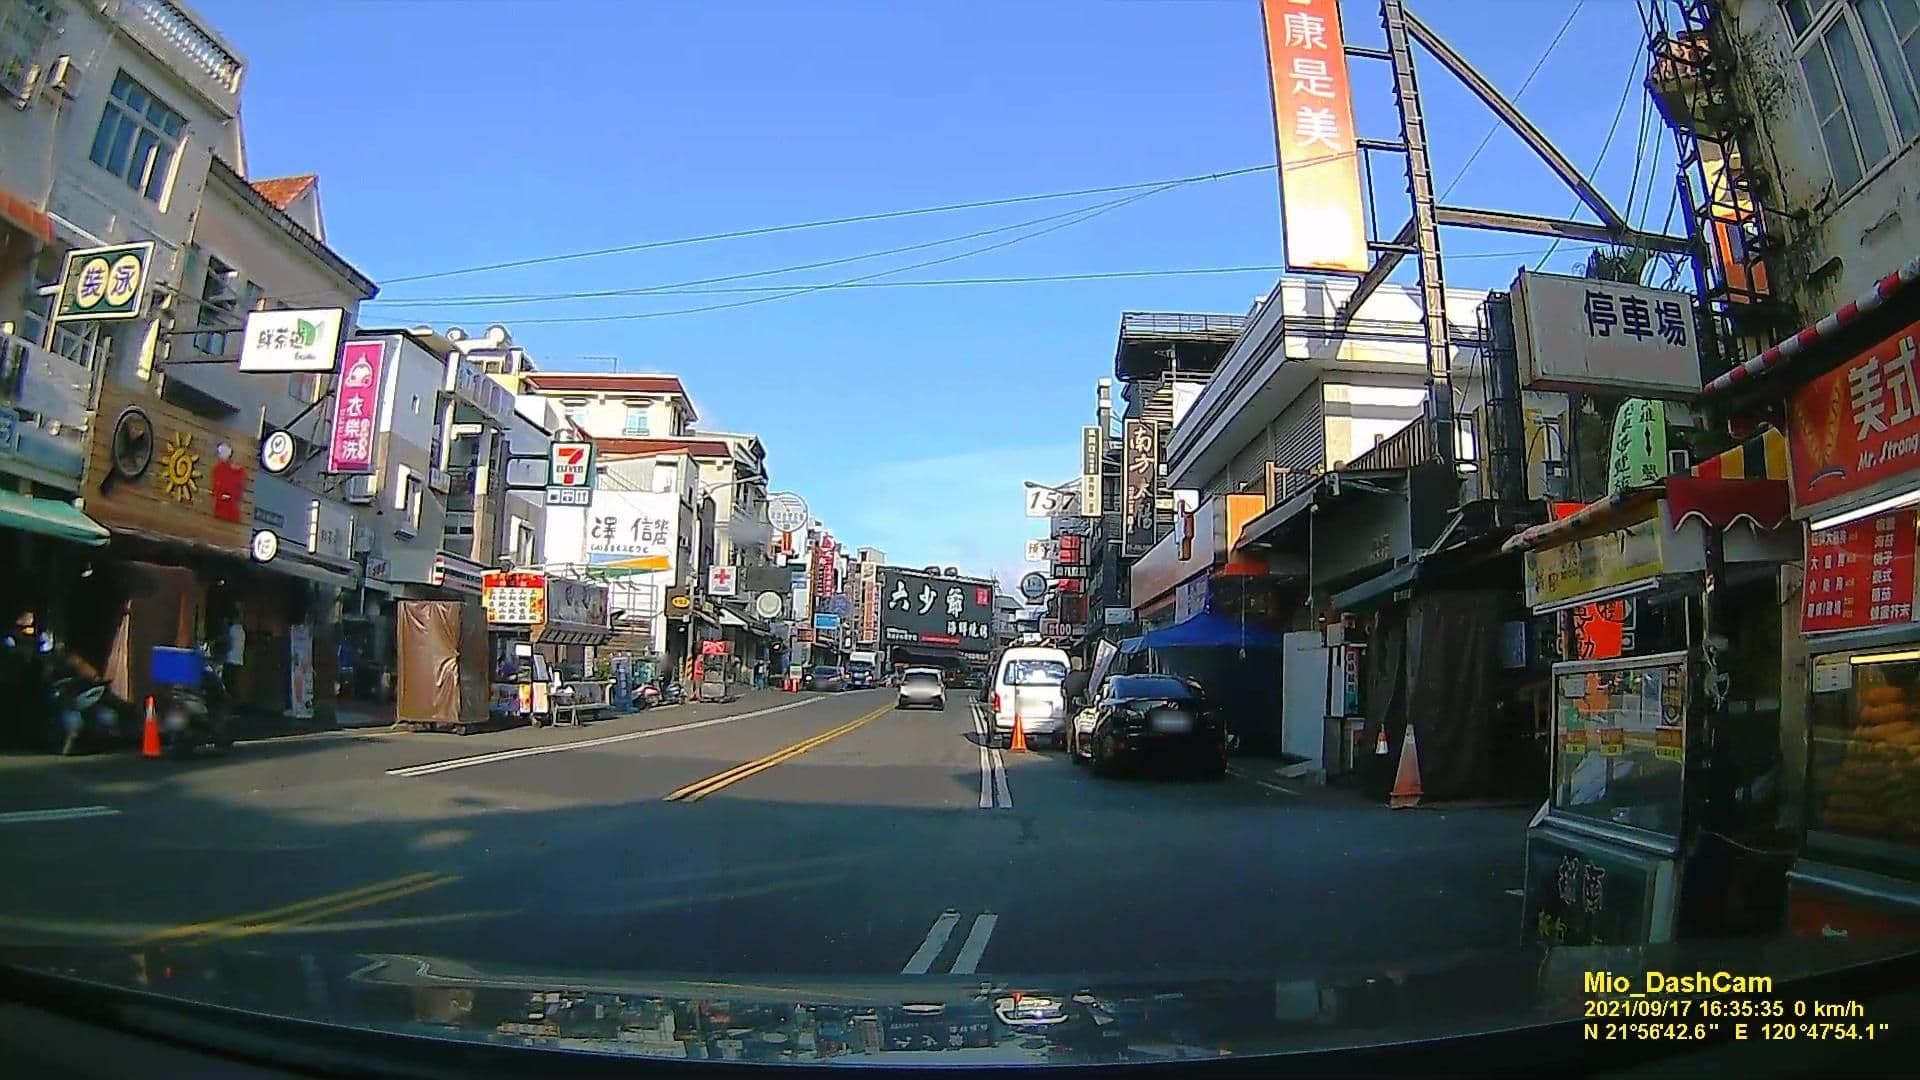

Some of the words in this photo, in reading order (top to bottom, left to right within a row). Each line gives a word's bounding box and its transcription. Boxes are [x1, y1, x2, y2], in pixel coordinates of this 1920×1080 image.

[1283, 12, 1343, 154] 康是美
[1583, 289, 1687, 347] 停車場
[1032, 490, 1077, 512] 157
